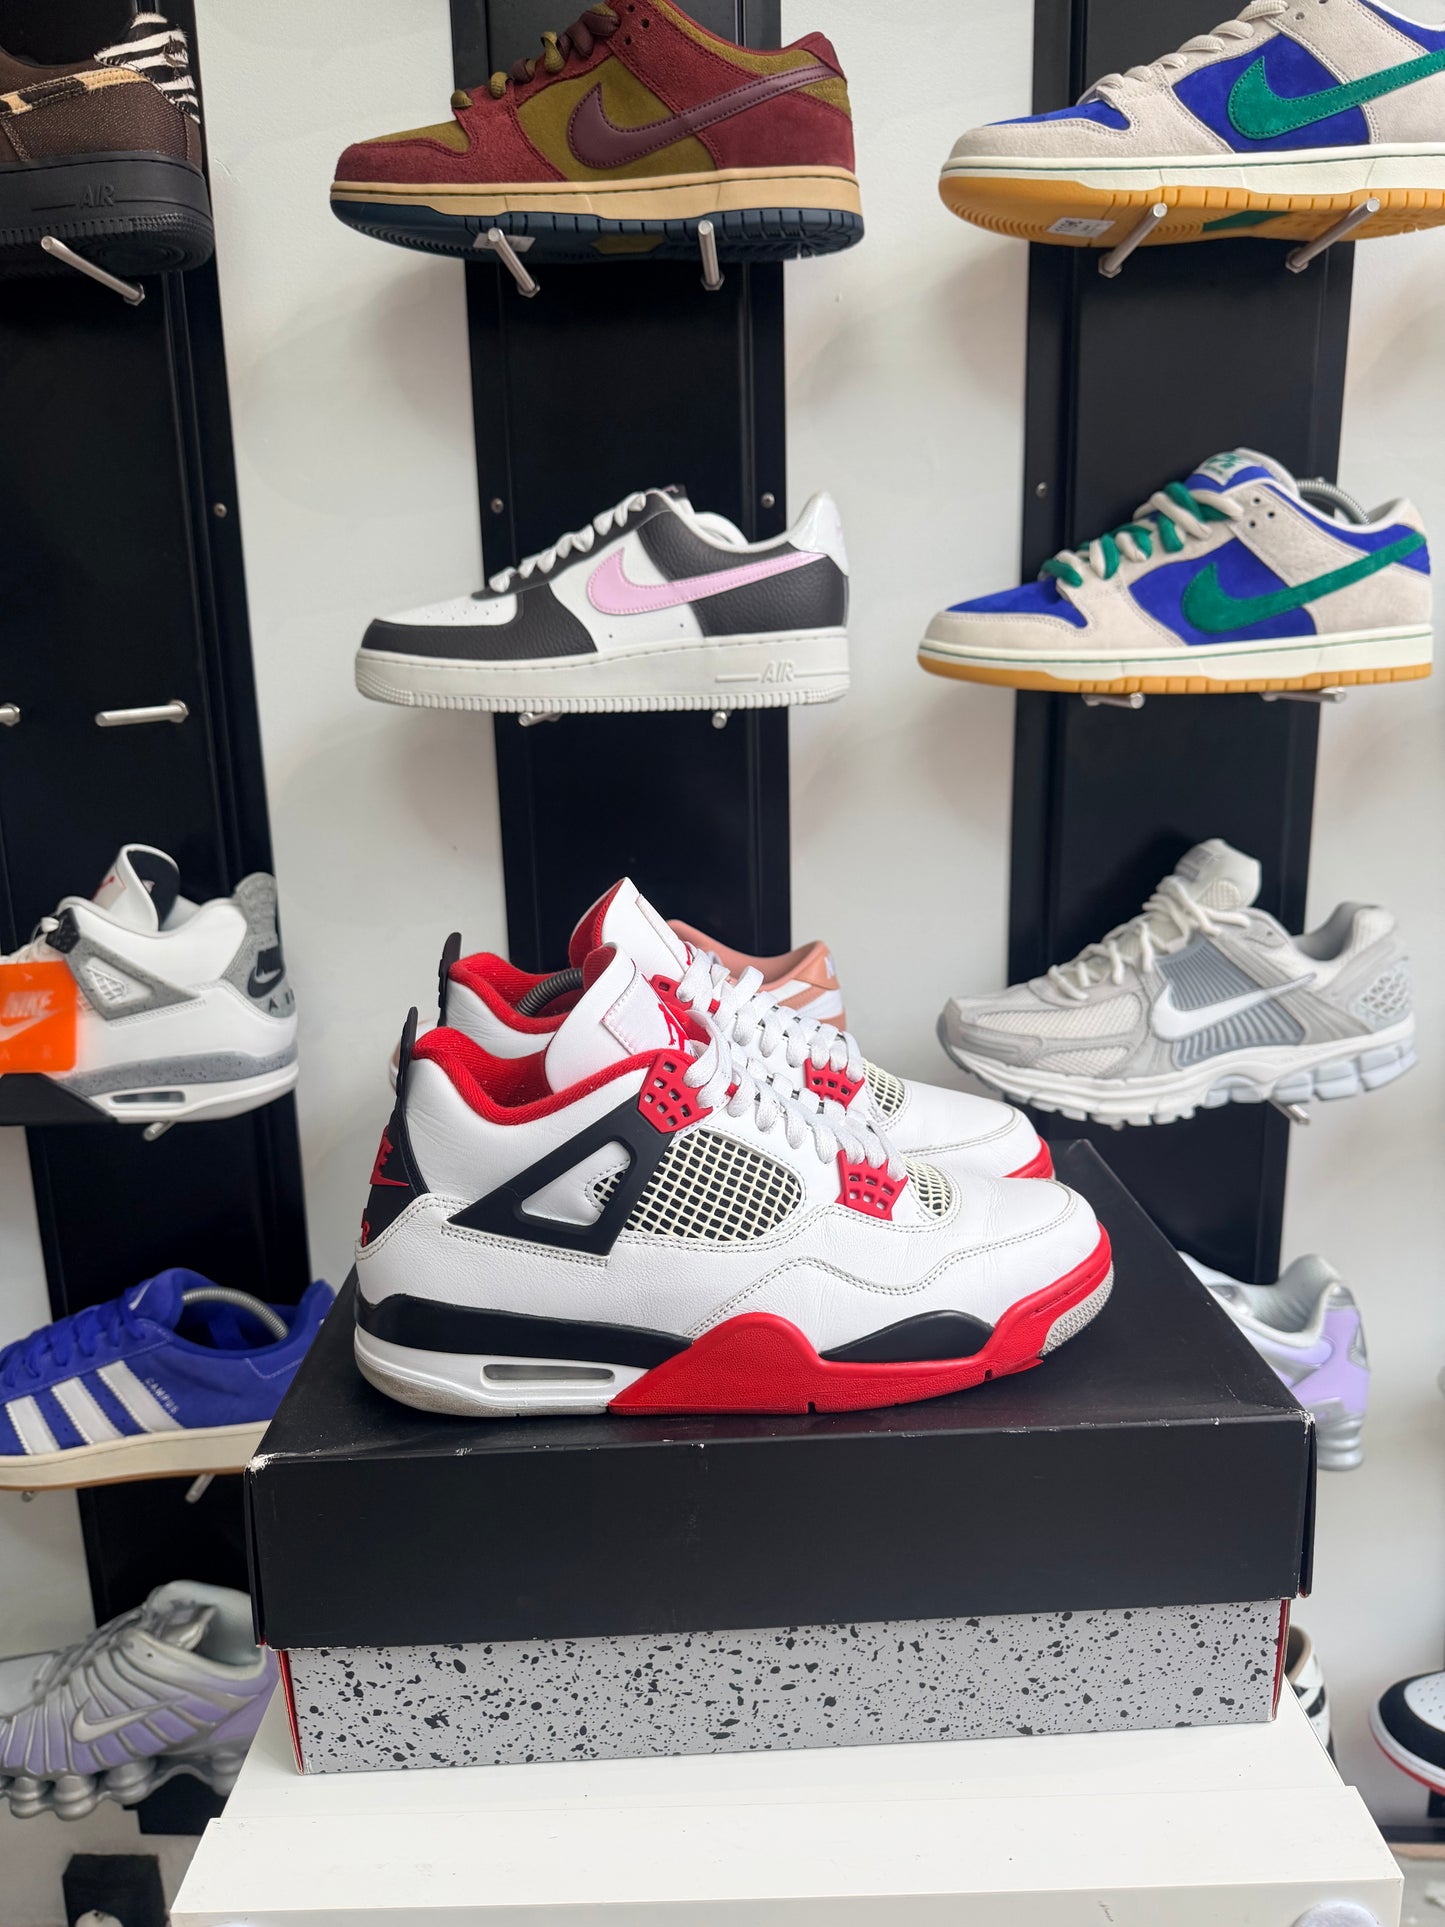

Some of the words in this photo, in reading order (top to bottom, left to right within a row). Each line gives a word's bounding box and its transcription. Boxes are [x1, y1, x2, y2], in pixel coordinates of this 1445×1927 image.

[81, 184, 114, 208] AIR
[760, 660, 794, 683] AIR
[144, 1377, 180, 1414] CAMPUS
